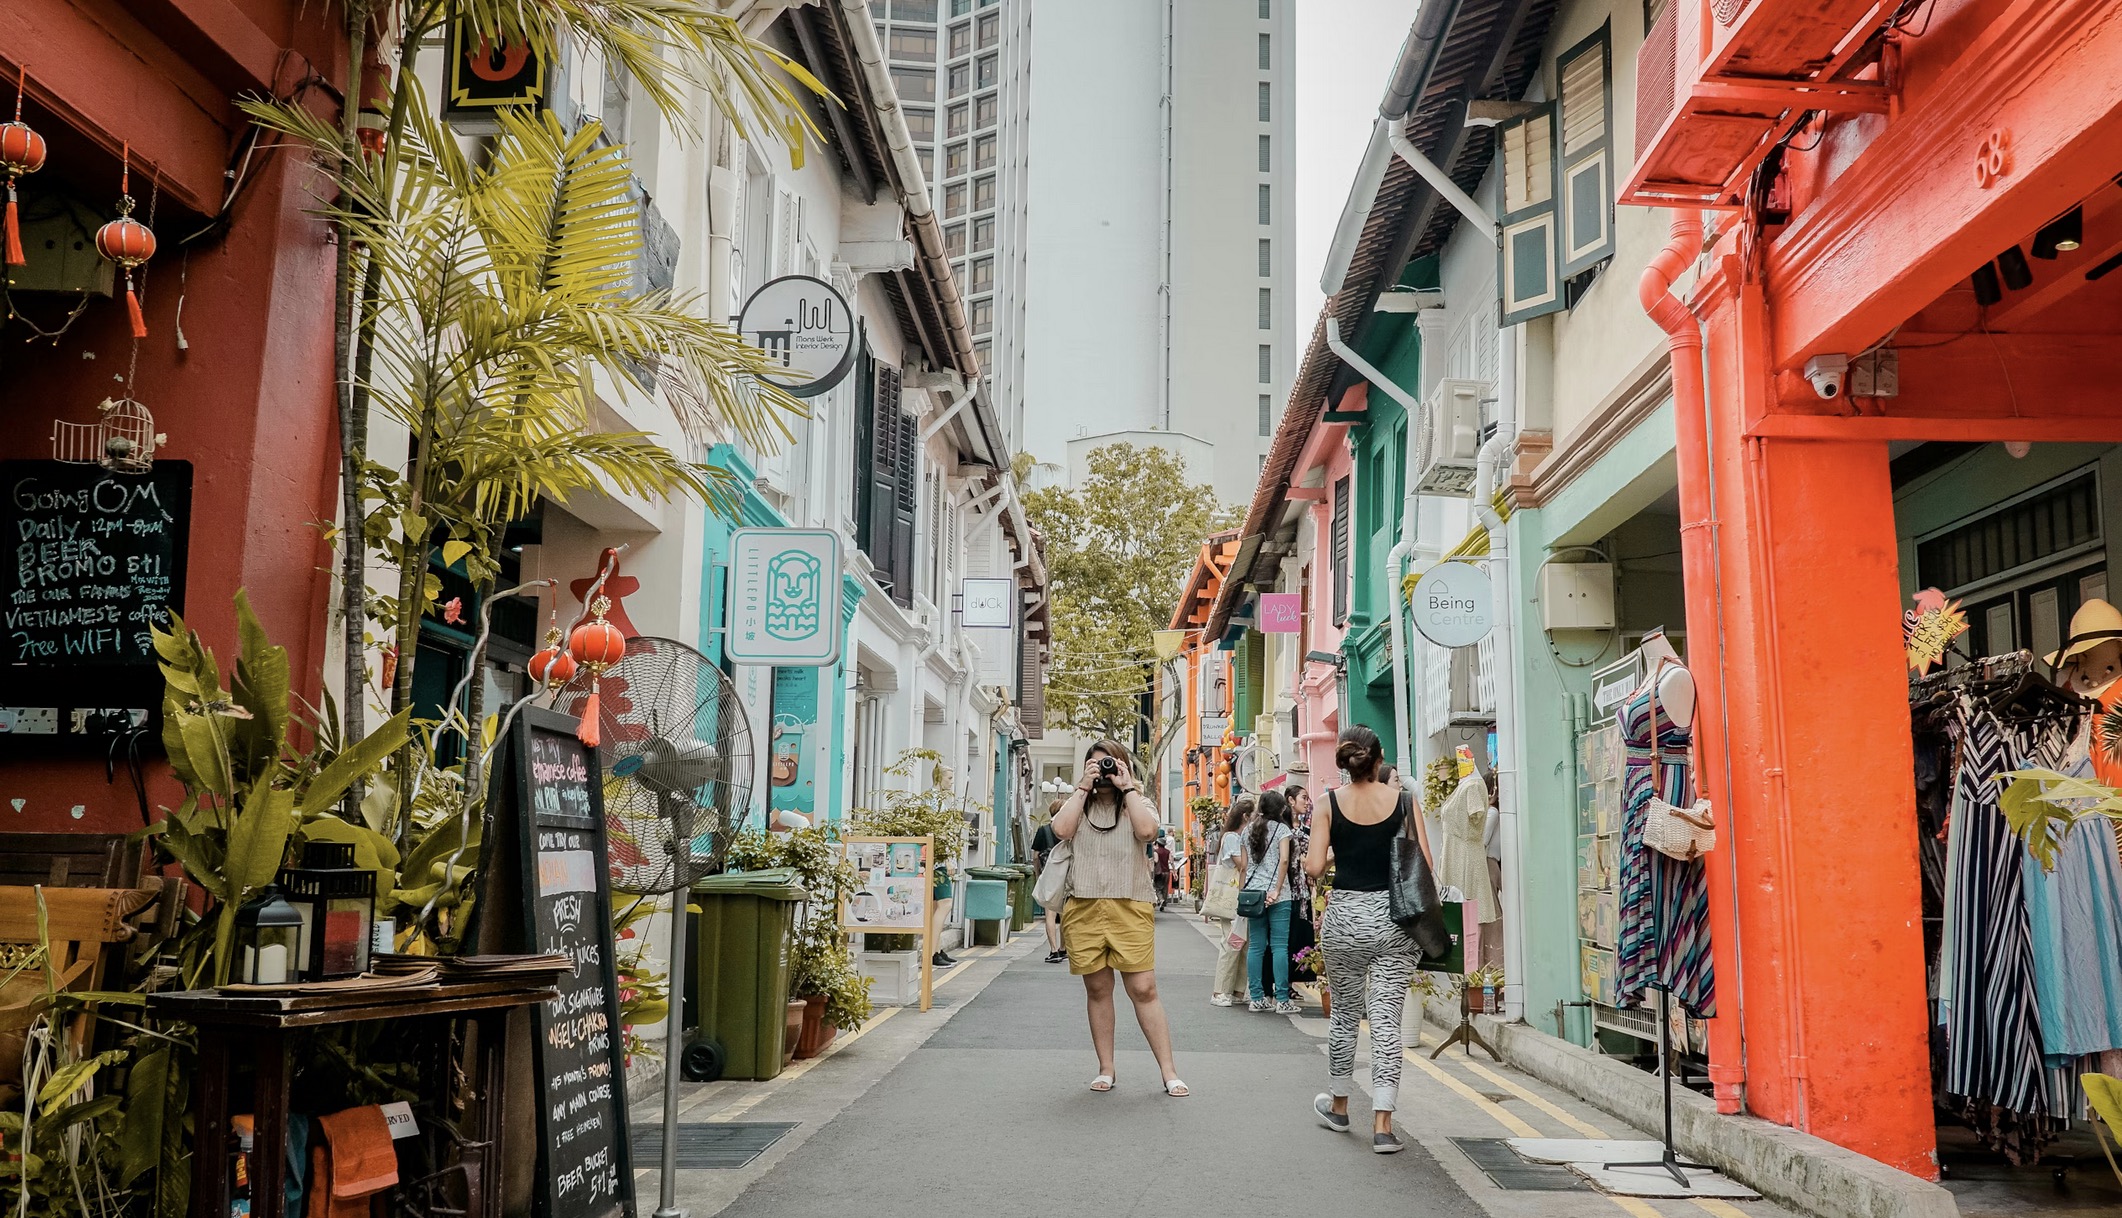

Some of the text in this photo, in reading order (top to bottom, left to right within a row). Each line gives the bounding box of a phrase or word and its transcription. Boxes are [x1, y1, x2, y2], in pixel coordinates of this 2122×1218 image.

[1973, 127, 2003, 188] 68
[821, 343, 843, 351] Design
[14, 478, 174, 523] Going OM
[17, 515, 80, 541] Daily
[17, 538, 101, 571] BEER
[18, 555, 116, 587] PROMO
[746, 548, 759, 611] LITTLEPO
[11, 589, 36, 604] THE
[42, 588, 72, 601] OUR
[1265, 604, 1294, 614] LADY
[1429, 596, 1475, 613] Being
[5, 604, 169, 629] VIETNAMESE coffee
[1277, 610, 1299, 623] luck
[1430, 612, 1485, 625] Centre
[1924, 631, 1942, 647] FOR
[1937, 615, 1953, 631] $36
[12, 628, 121, 660] Free WIFI
[1913, 623, 1931, 642] FOR
[574, 937, 600, 978] juices
[569, 987, 605, 1014] SIGNATURE
[578, 1012, 608, 1041] CHAKRA
[553, 1084, 612, 1122] ANY MAIN COURSE
[558, 1165, 584, 1197] BEER
[585, 1146, 608, 1171] BUCKET
